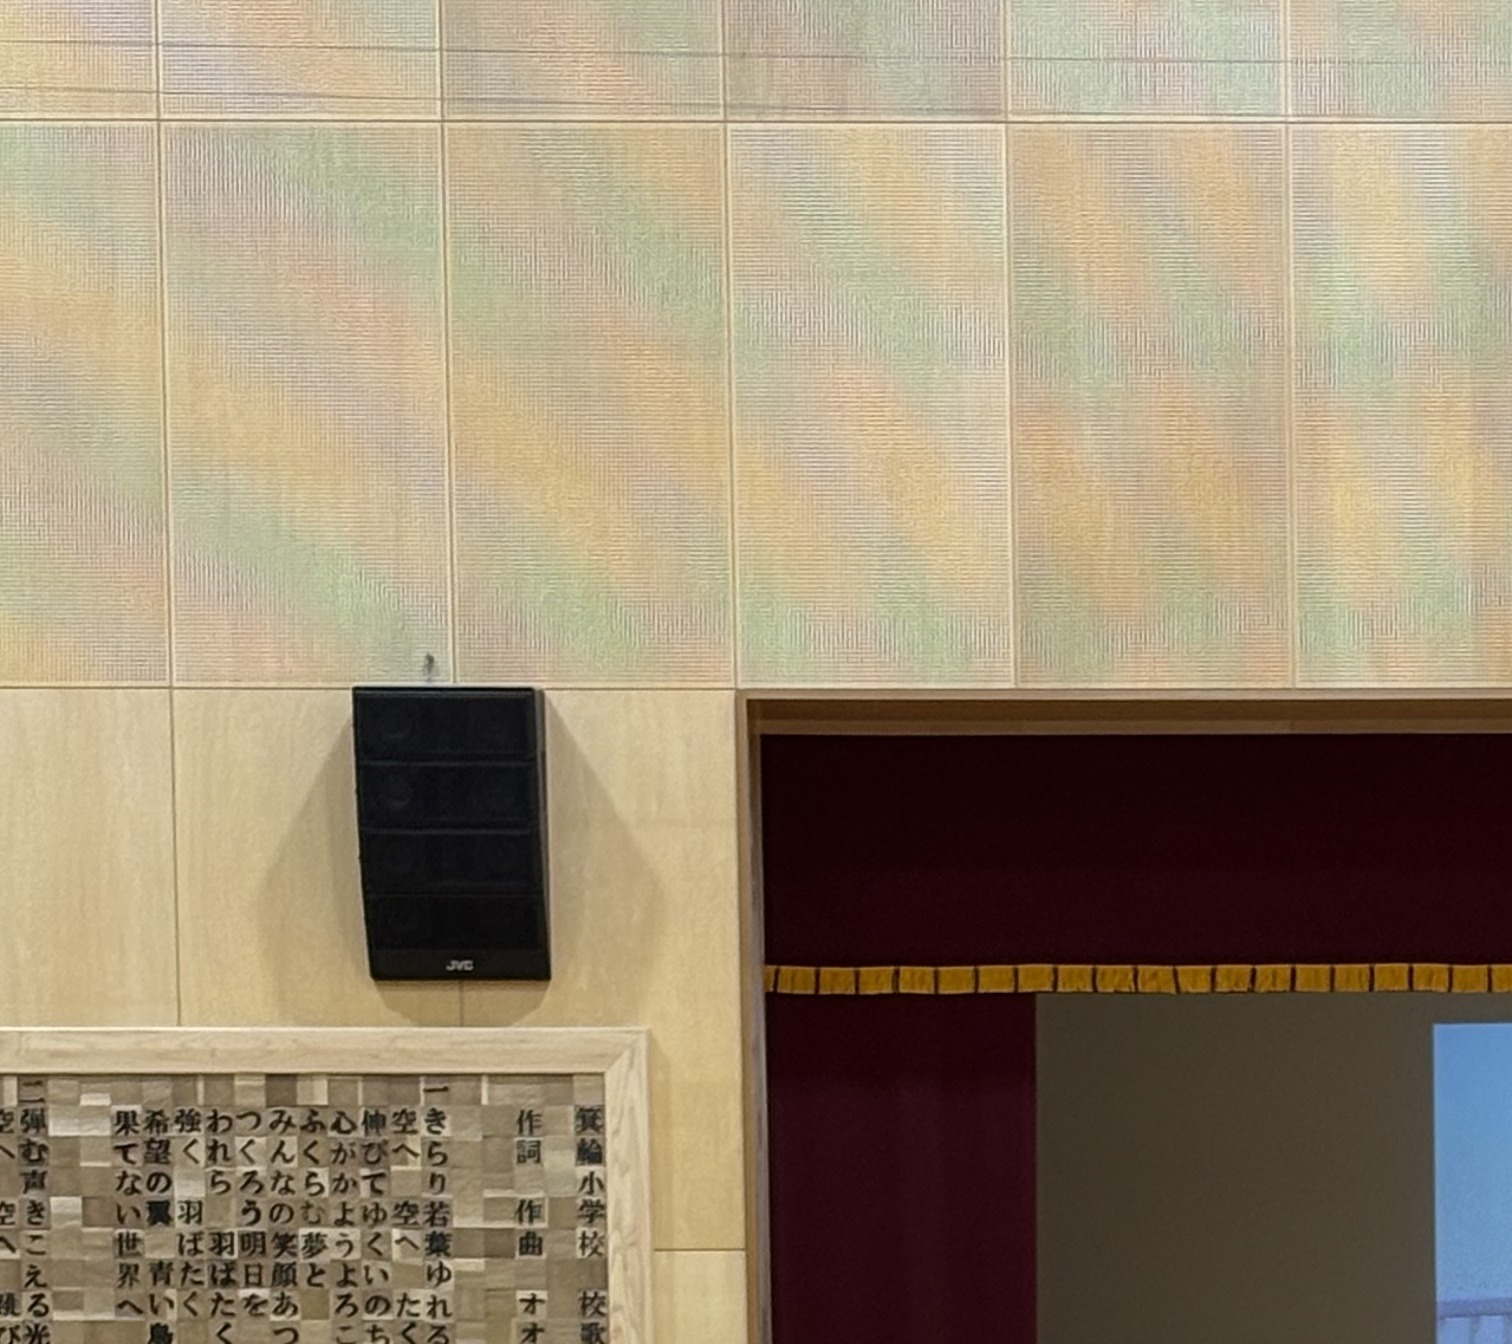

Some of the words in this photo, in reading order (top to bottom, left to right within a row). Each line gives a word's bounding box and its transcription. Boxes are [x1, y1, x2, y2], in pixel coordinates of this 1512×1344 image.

[446, 960, 474, 970] JVC
[143, 1108, 172, 1227] 希望の翼
[174, 1109, 202, 1165] 強く
[206, 1110, 233, 1194] われら
[392, 1108, 420, 1158] 空へ
[516, 1109, 542, 1164] 作詞
[114, 1109, 144, 1316] 果てない世界へ
[236, 1110, 268, 1317] つくろう明日を
[299, 1109, 328, 1287] ふくらむ夢と
[576, 1107, 605, 1258] 箕輪小学校
[176, 1202, 205, 1317] 羽ばたく
[393, 1201, 420, 1251] 空へ
[514, 1199, 543, 1257] 作曲
